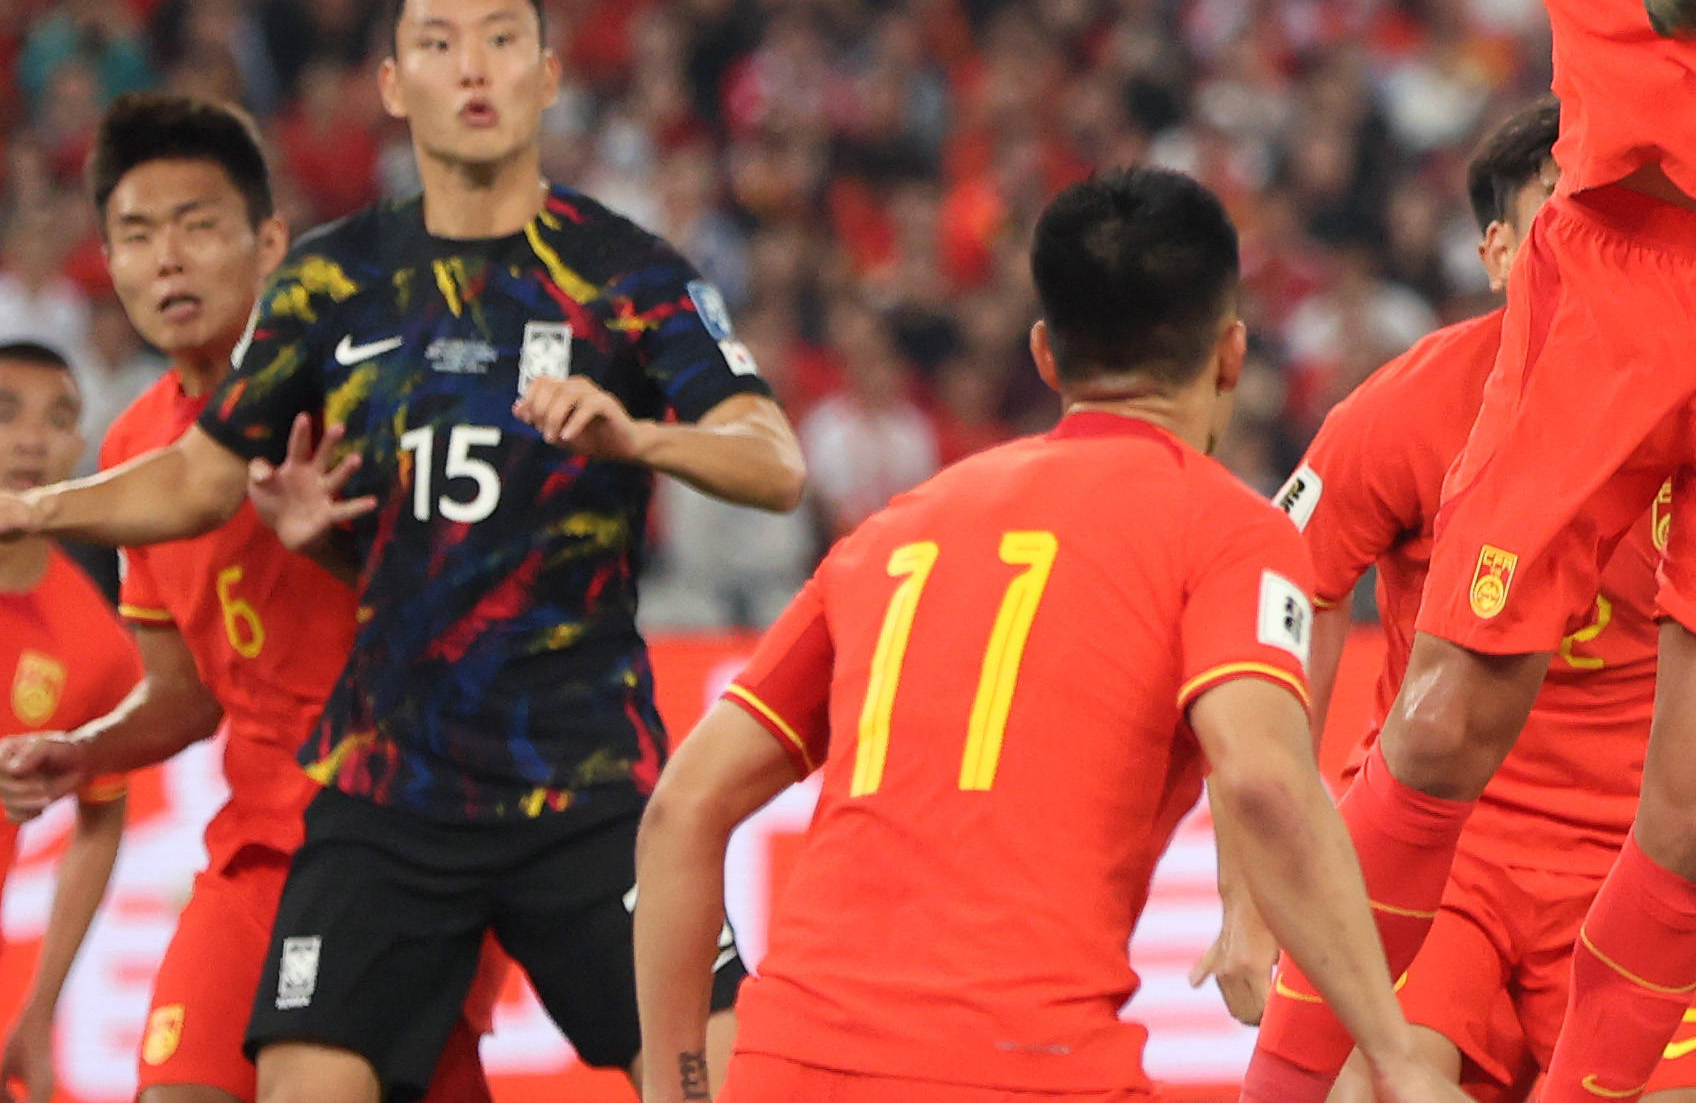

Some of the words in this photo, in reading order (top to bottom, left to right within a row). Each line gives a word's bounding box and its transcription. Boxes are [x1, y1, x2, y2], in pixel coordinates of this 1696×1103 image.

[399, 425, 502, 523] 15
[216, 565, 266, 658] 6
[850, 531, 1059, 798] 11
